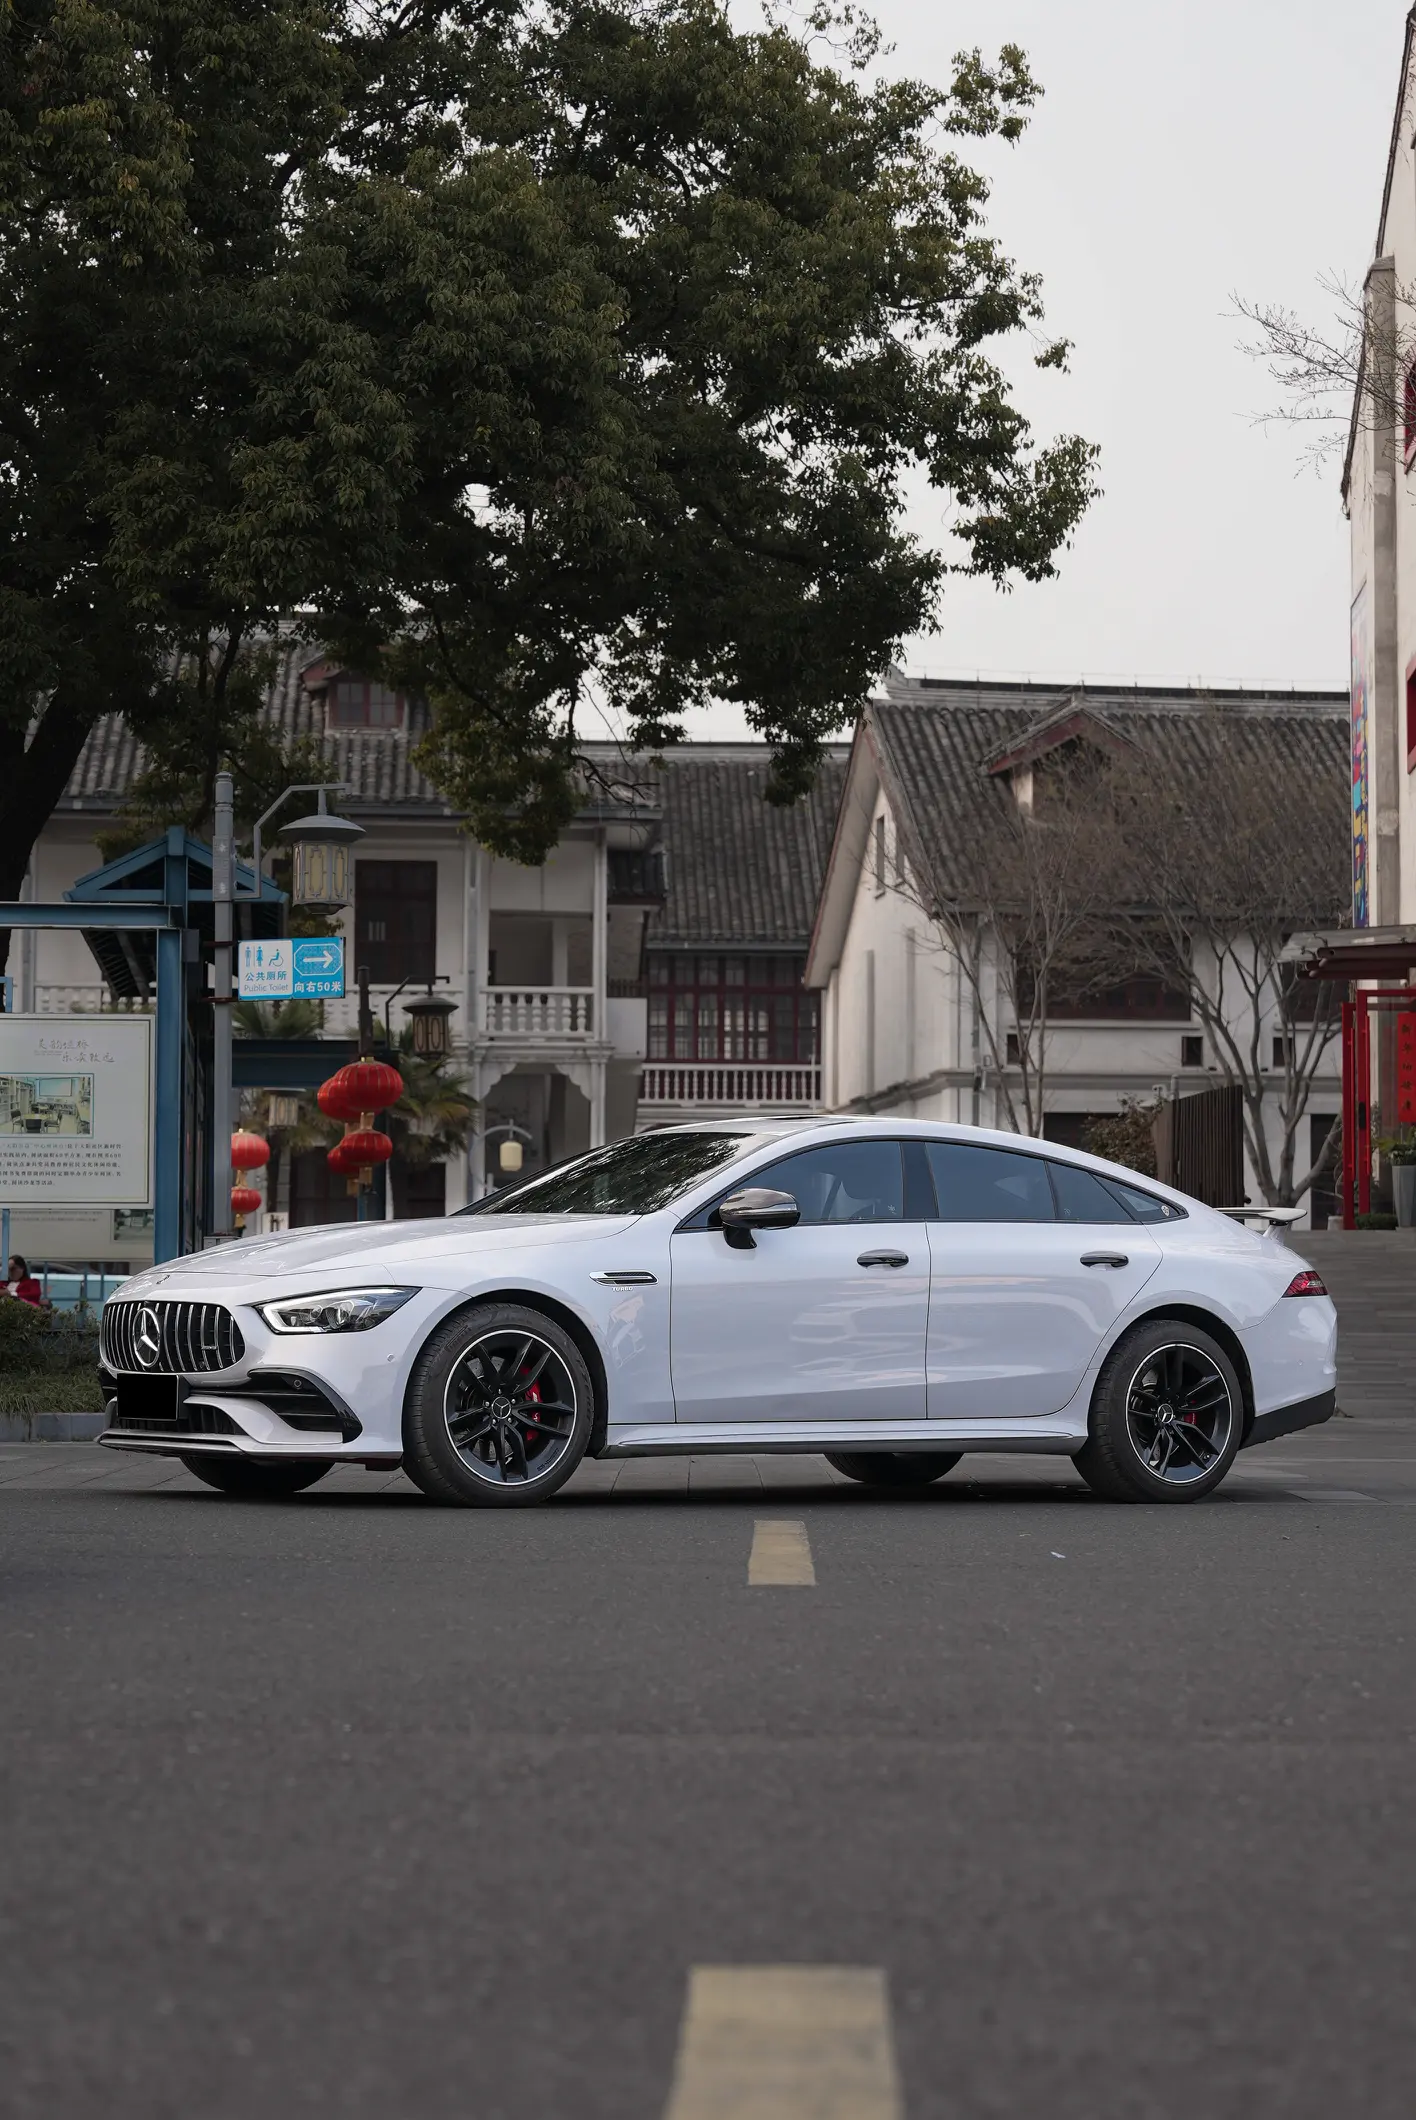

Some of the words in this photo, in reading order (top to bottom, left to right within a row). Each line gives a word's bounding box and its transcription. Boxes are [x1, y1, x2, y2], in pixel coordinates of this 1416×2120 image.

[245, 970, 287, 982] 公共厕所
[244, 984, 267, 992] Public
[269, 983, 288, 991] Toilet
[294, 981, 342, 993] 向右50米
